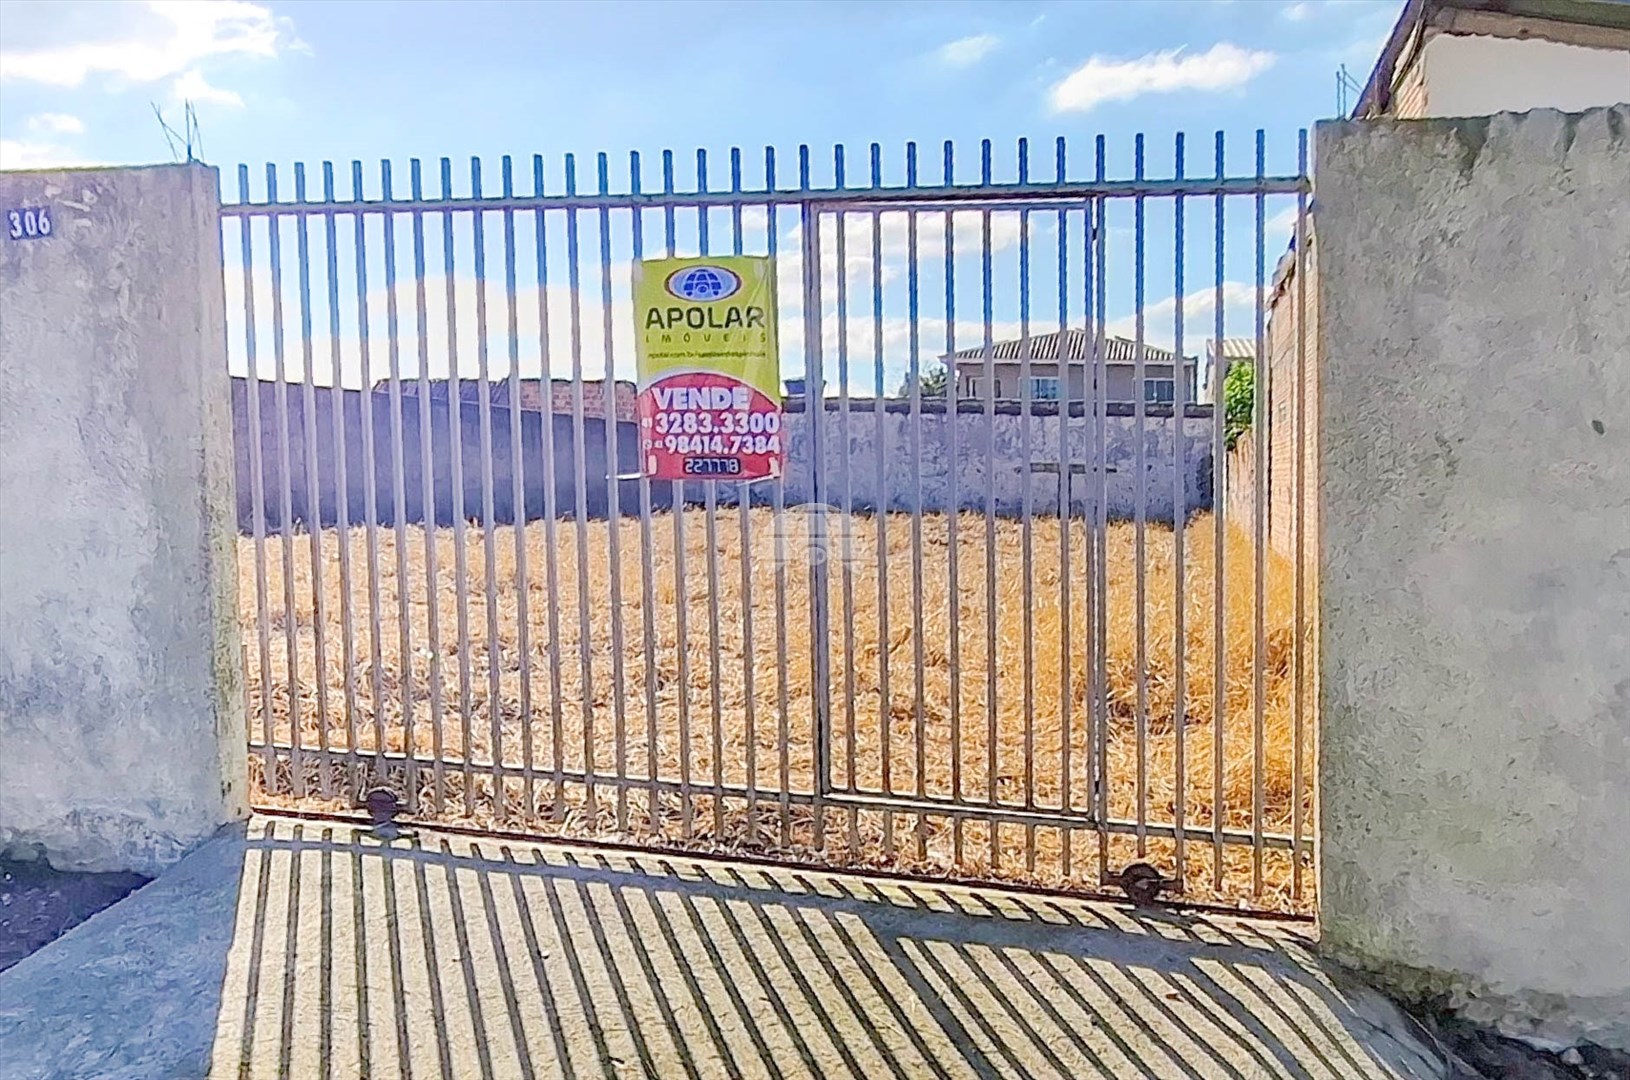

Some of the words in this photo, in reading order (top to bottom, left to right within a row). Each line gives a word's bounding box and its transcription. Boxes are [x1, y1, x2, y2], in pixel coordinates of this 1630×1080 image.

[9, 209, 51, 238] 306
[645, 306, 765, 329] APOLAR
[650, 386, 750, 410] VENDE
[655, 412, 780, 434] 3283.3300
[664, 435, 780, 454] 98414.7384
